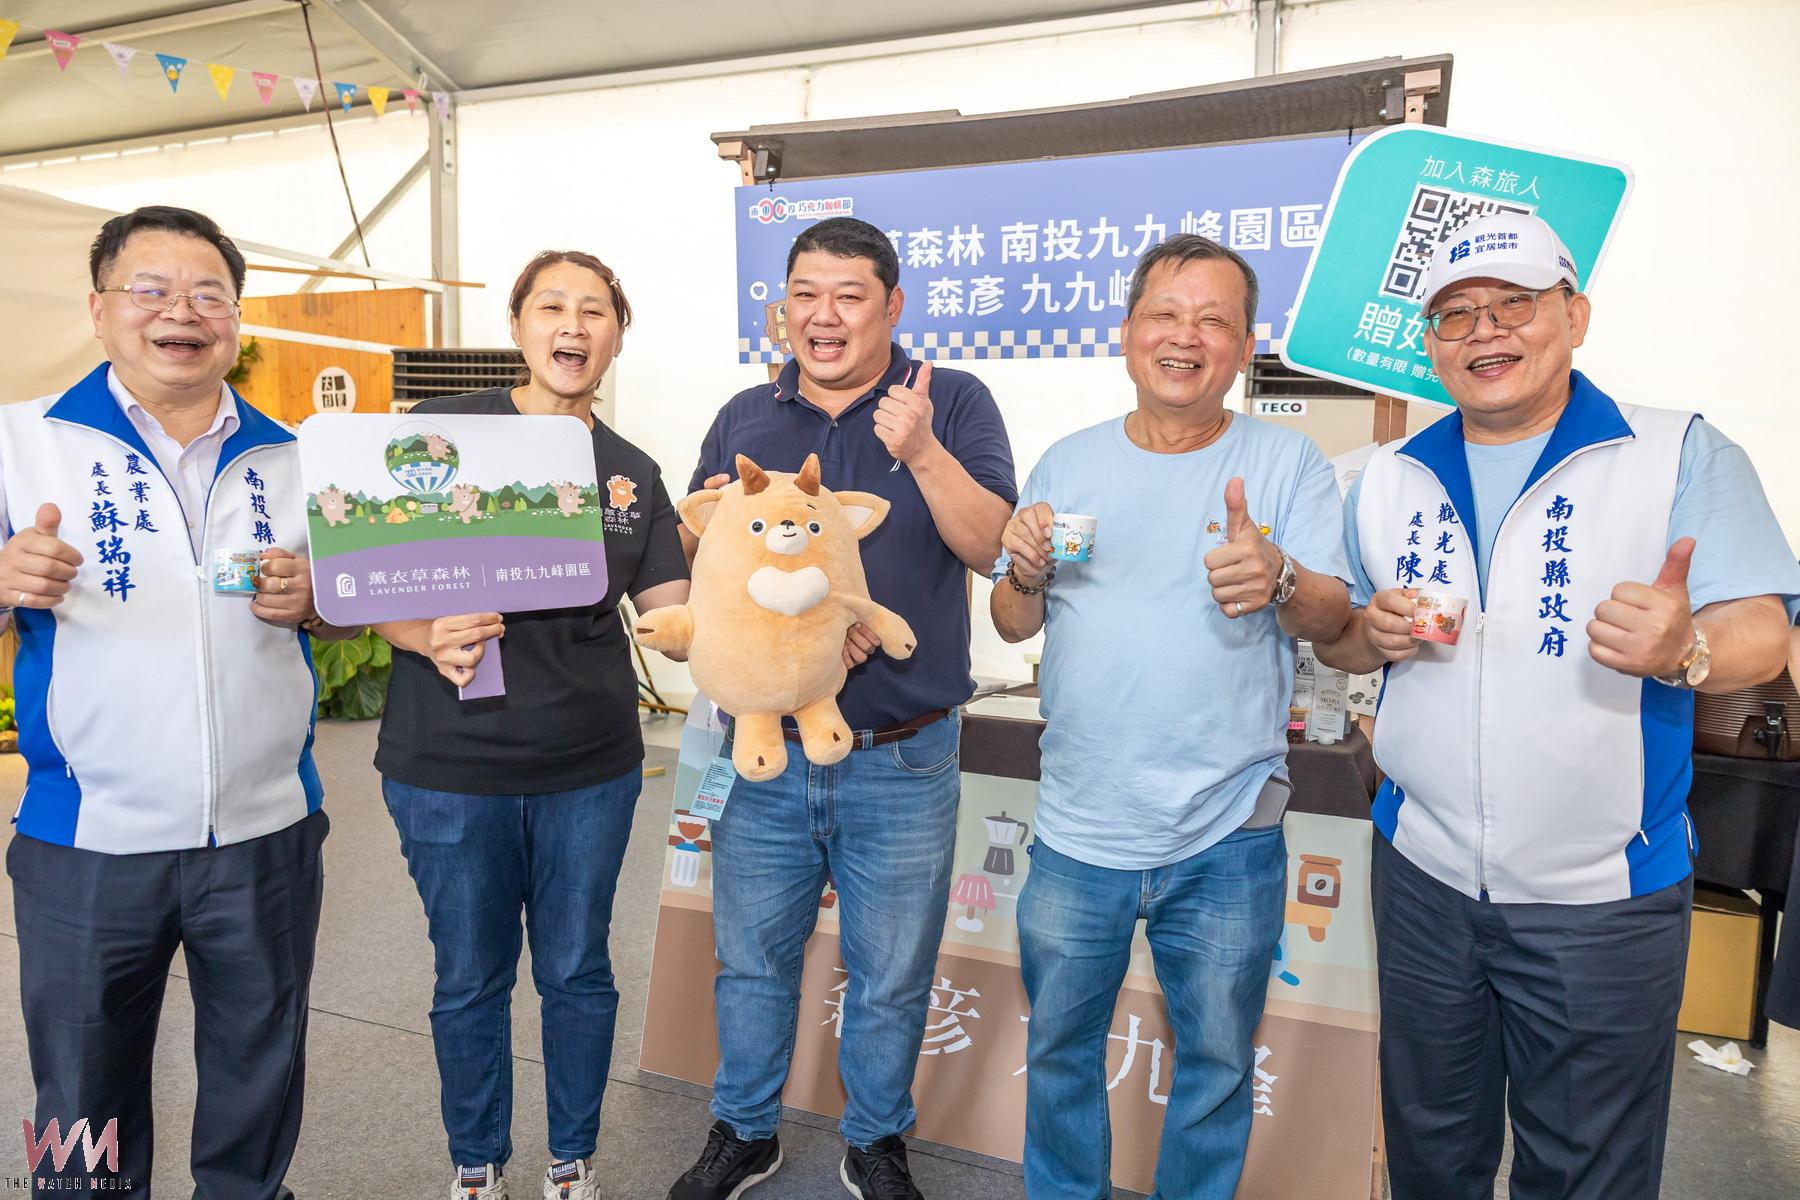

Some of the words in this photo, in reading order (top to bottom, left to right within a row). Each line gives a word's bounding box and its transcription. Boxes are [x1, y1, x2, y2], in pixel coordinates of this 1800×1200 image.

[1419, 155, 1542, 200] 加入森旅人
[889, 224, 985, 269] 森林
[1474, 232, 1519, 243] 觀光首都
[1474, 242, 1519, 254] 宜居城市
[926, 274, 1005, 318] 森彥
[1261, 402, 1303, 413] TECO
[124, 452, 160, 533] 農業處
[243, 467, 276, 552] 南投縣
[1396, 511, 1425, 589] 處長陳
[1427, 502, 1459, 584] 觀光處
[368, 565, 471, 585] 薰衣草森林
[495, 562, 592, 582] 南投九九峰園區
[369, 585, 427, 596] LAVENDER
[432, 582, 471, 591] FOREST
[1537, 495, 1574, 658] 南投縣政府
